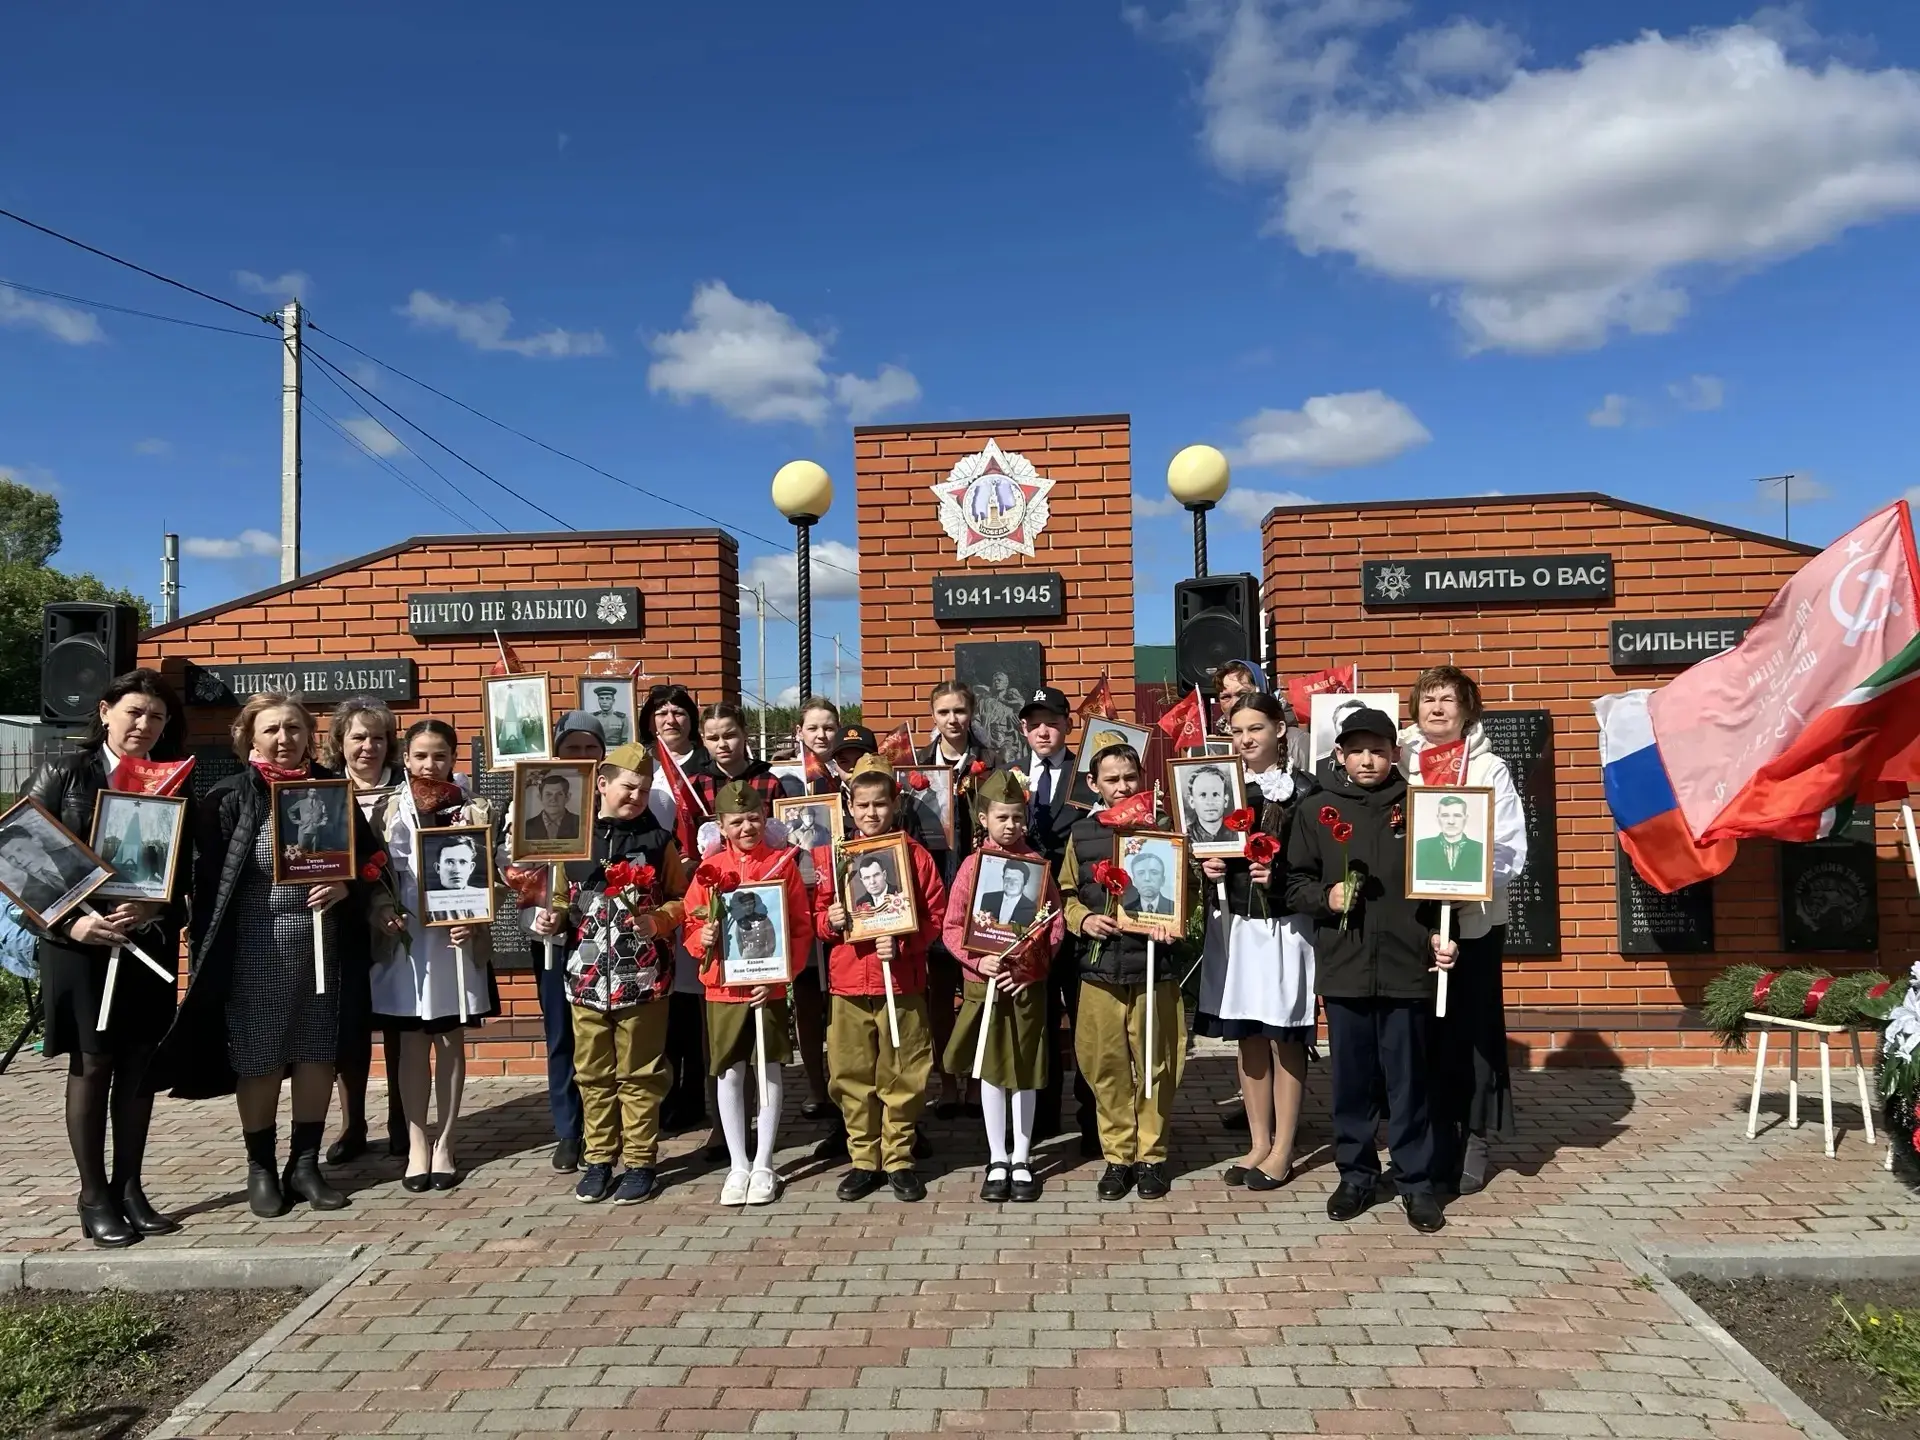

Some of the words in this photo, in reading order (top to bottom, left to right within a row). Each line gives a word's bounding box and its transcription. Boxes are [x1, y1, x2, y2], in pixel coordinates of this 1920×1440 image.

[980, 526, 1009, 535] ПОБЕДА
[1425, 569, 1525, 590] ПАМЯТЬ
[1532, 567, 1551, 587] О
[1558, 566, 1606, 586] ВАС
[944, 585, 1051, 606] 1941-1945
[409, 603, 474, 625] НИЧТО
[480, 601, 505, 621] НЕ
[511, 598, 587, 620] ЗАБЫТО
[1618, 630, 1736, 652] СИЛЬНЕЕ
[233, 673, 297, 694] НИКТО
[303, 671, 328, 692] НЕ
[1033, 689, 1046, 701] LA
